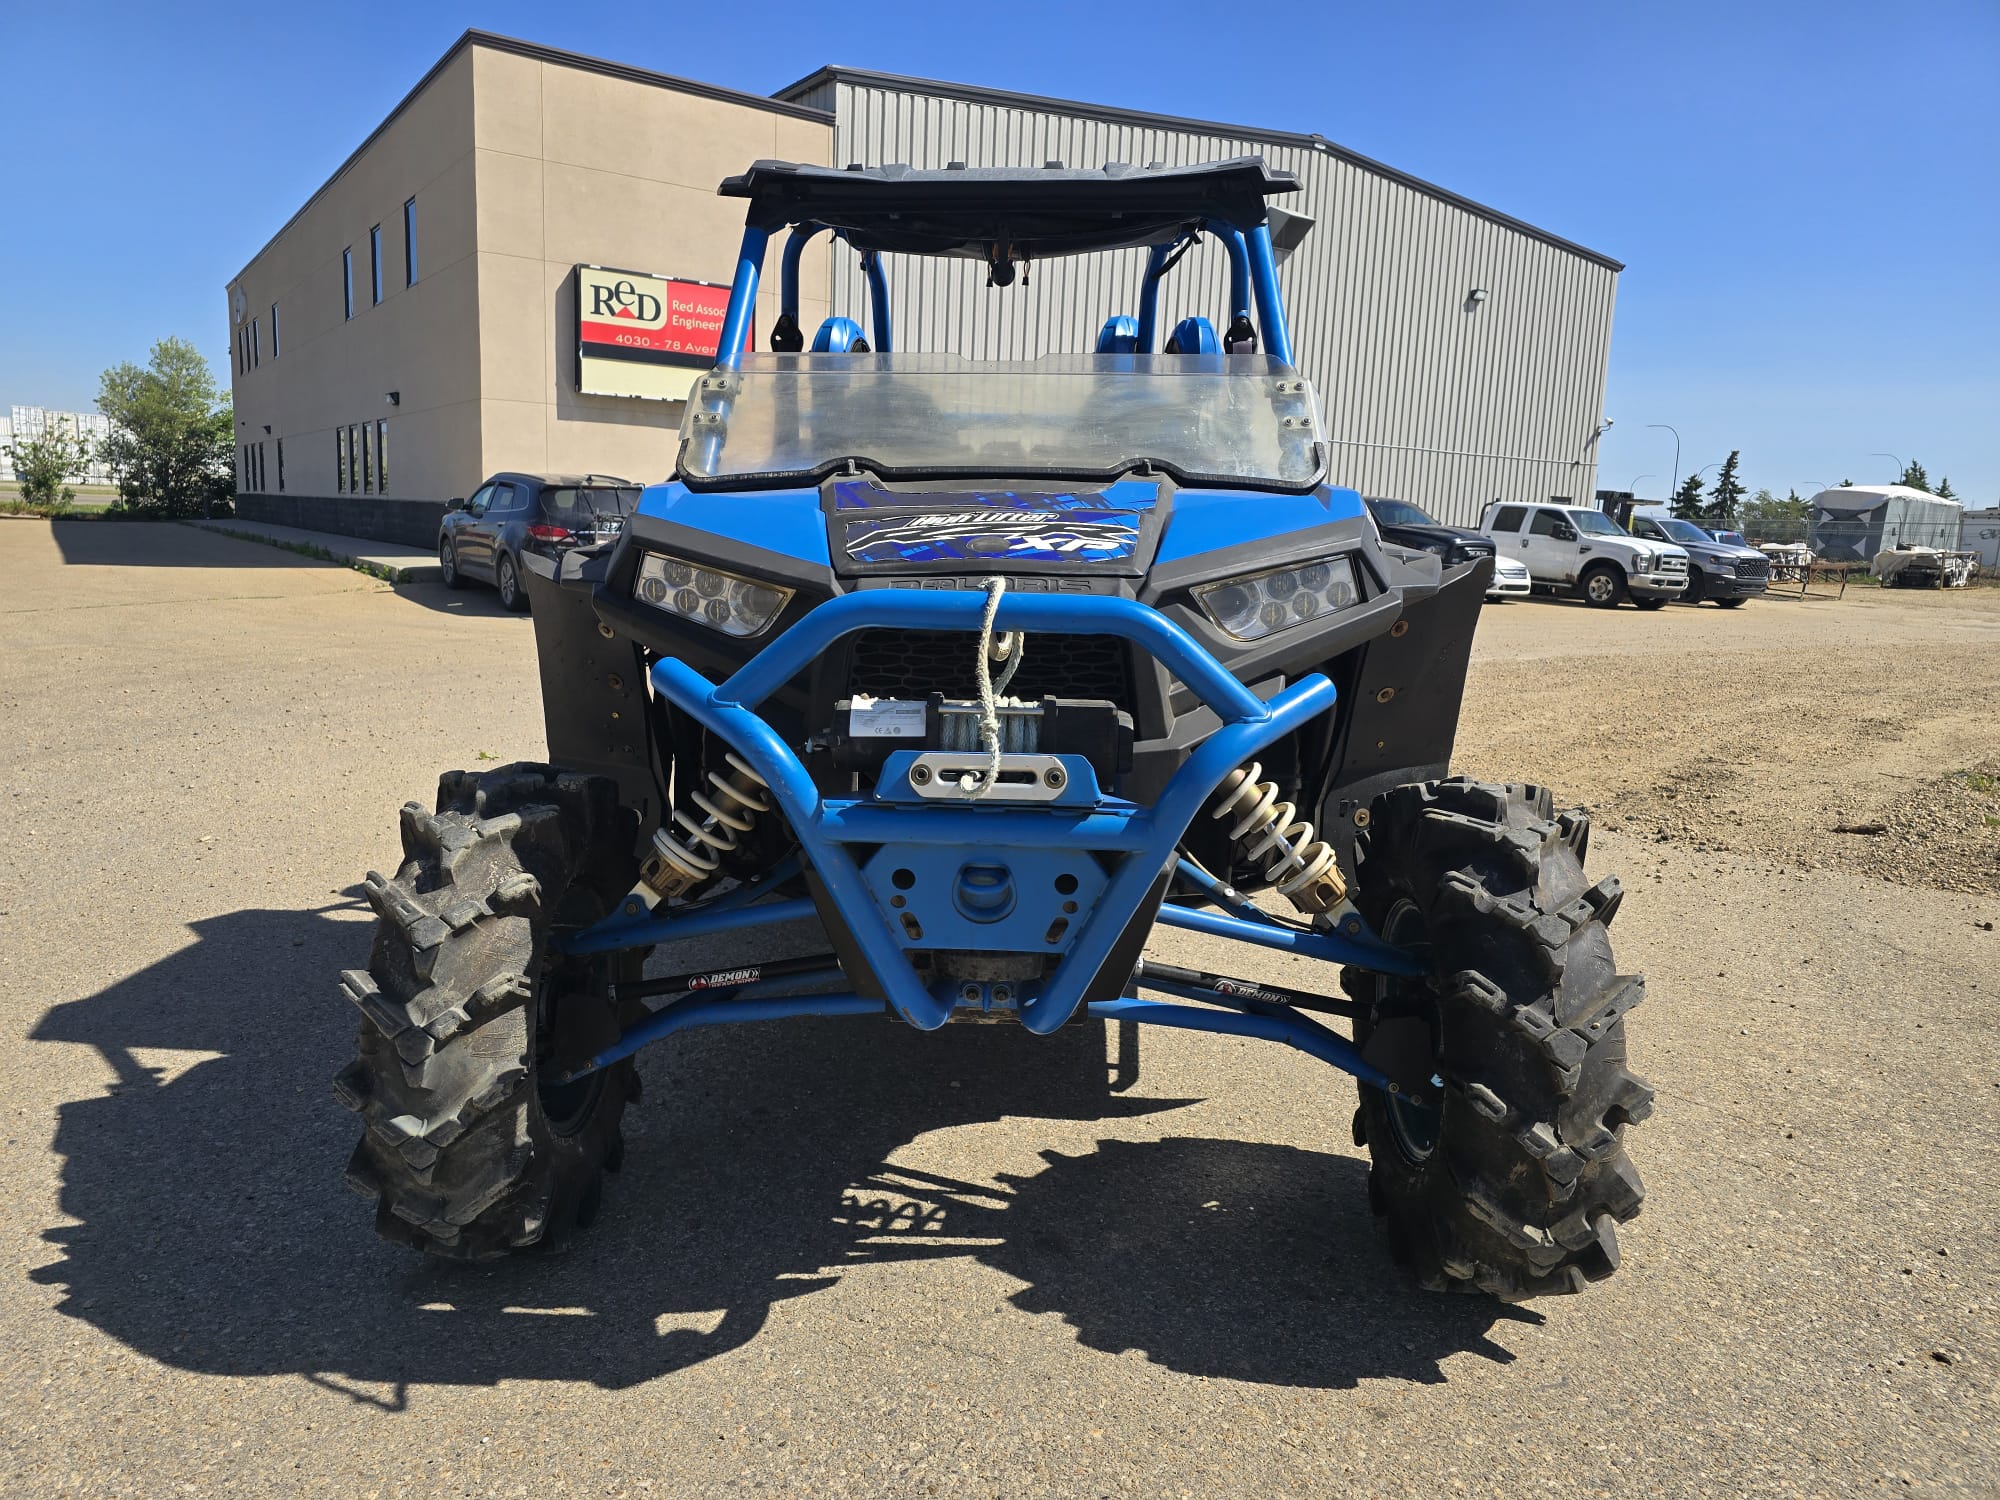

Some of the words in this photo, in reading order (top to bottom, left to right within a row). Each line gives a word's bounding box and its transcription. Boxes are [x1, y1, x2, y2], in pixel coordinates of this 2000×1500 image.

[672, 299, 694, 313] Red
[615, 334, 650, 347] 4030
[664, 339, 681, 351] 78
[974, 511, 1053, 523] Lifter
[1008, 536, 1120, 551] XP
[711, 969, 751, 984] DEMON
[1238, 986, 1281, 1002] DEMON
